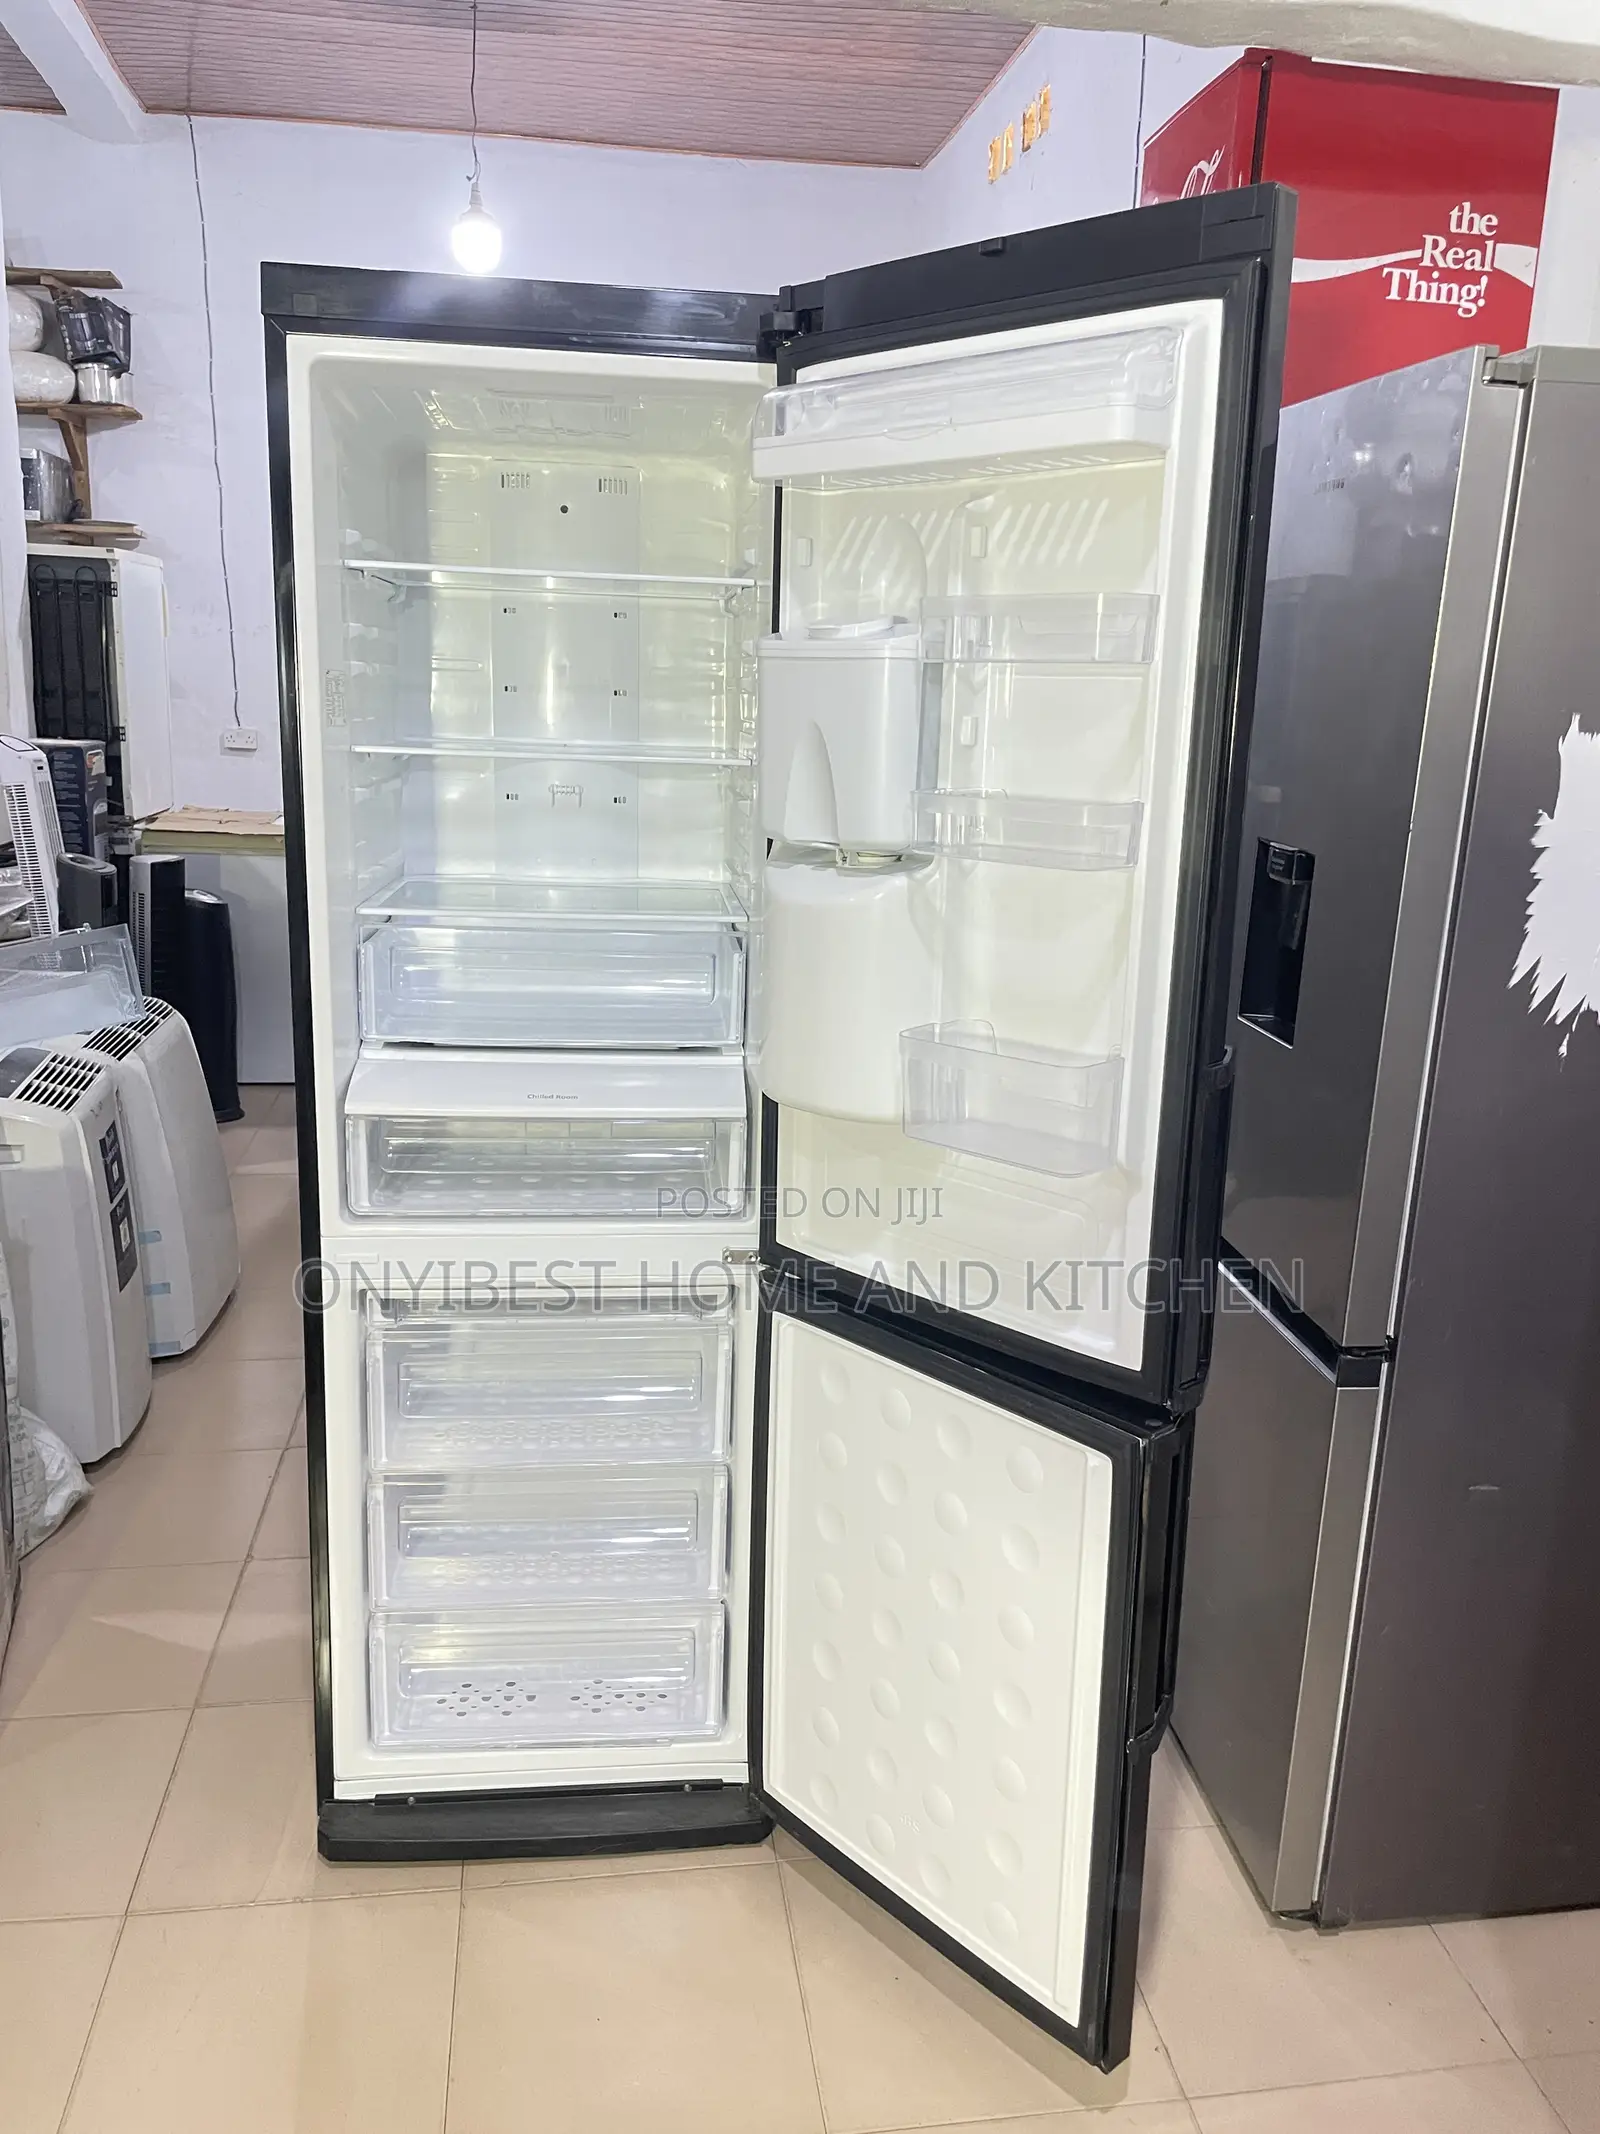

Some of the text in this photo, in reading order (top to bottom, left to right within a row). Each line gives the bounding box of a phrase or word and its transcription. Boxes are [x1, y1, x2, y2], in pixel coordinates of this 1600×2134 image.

[1449, 201, 1498, 236] the
[1419, 234, 1494, 272] Real
[1382, 267, 1488, 318] Thing!
